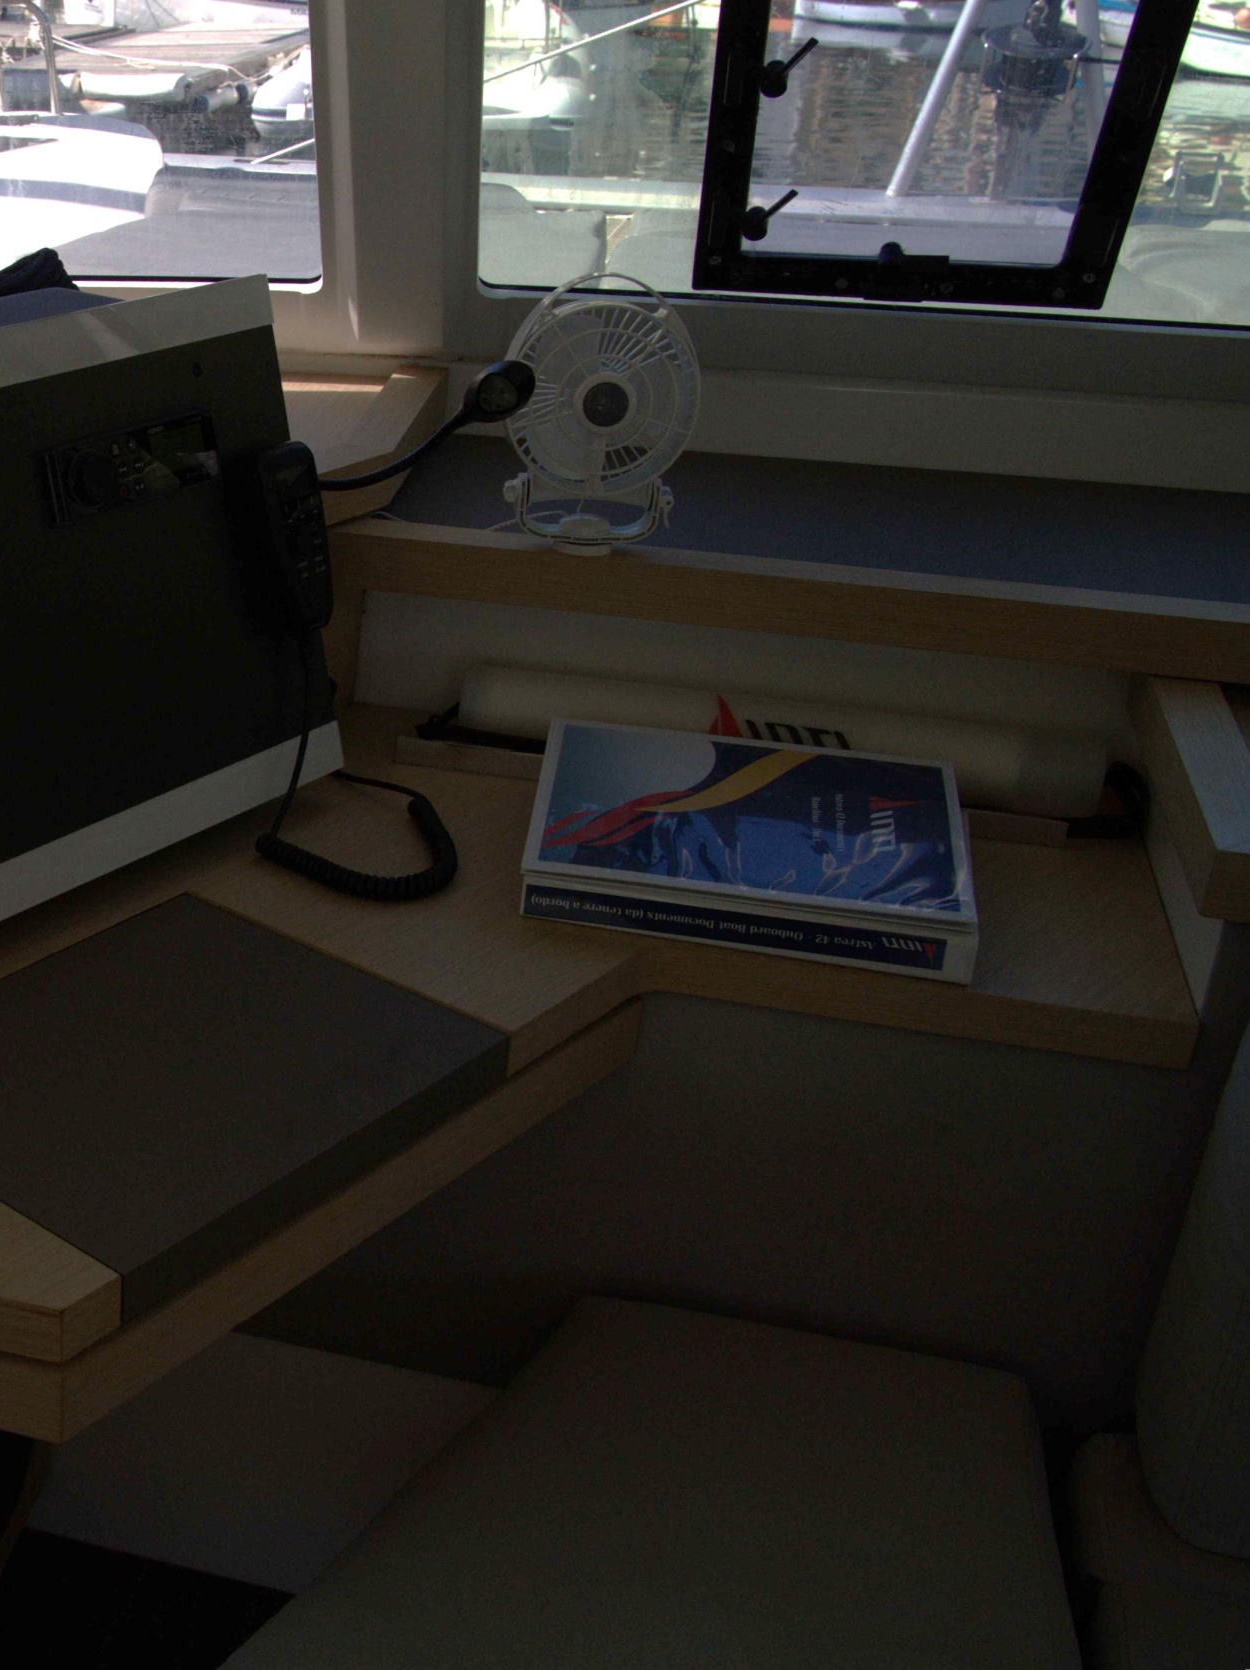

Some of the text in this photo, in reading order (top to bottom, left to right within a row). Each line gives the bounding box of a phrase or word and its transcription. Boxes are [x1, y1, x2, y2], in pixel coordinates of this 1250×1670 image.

[531, 893, 570, 910] bordo)
[572, 900, 581, 908] a
[582, 902, 622, 915] tenere
[625, 906, 644, 920] (da
[646, 911, 715, 929] Documents
[718, 920, 747, 934] Boat
[749, 923, 804, 941] Onboard
[815, 933, 832, 945] 42
[834, 935, 877, 950] Astrea
